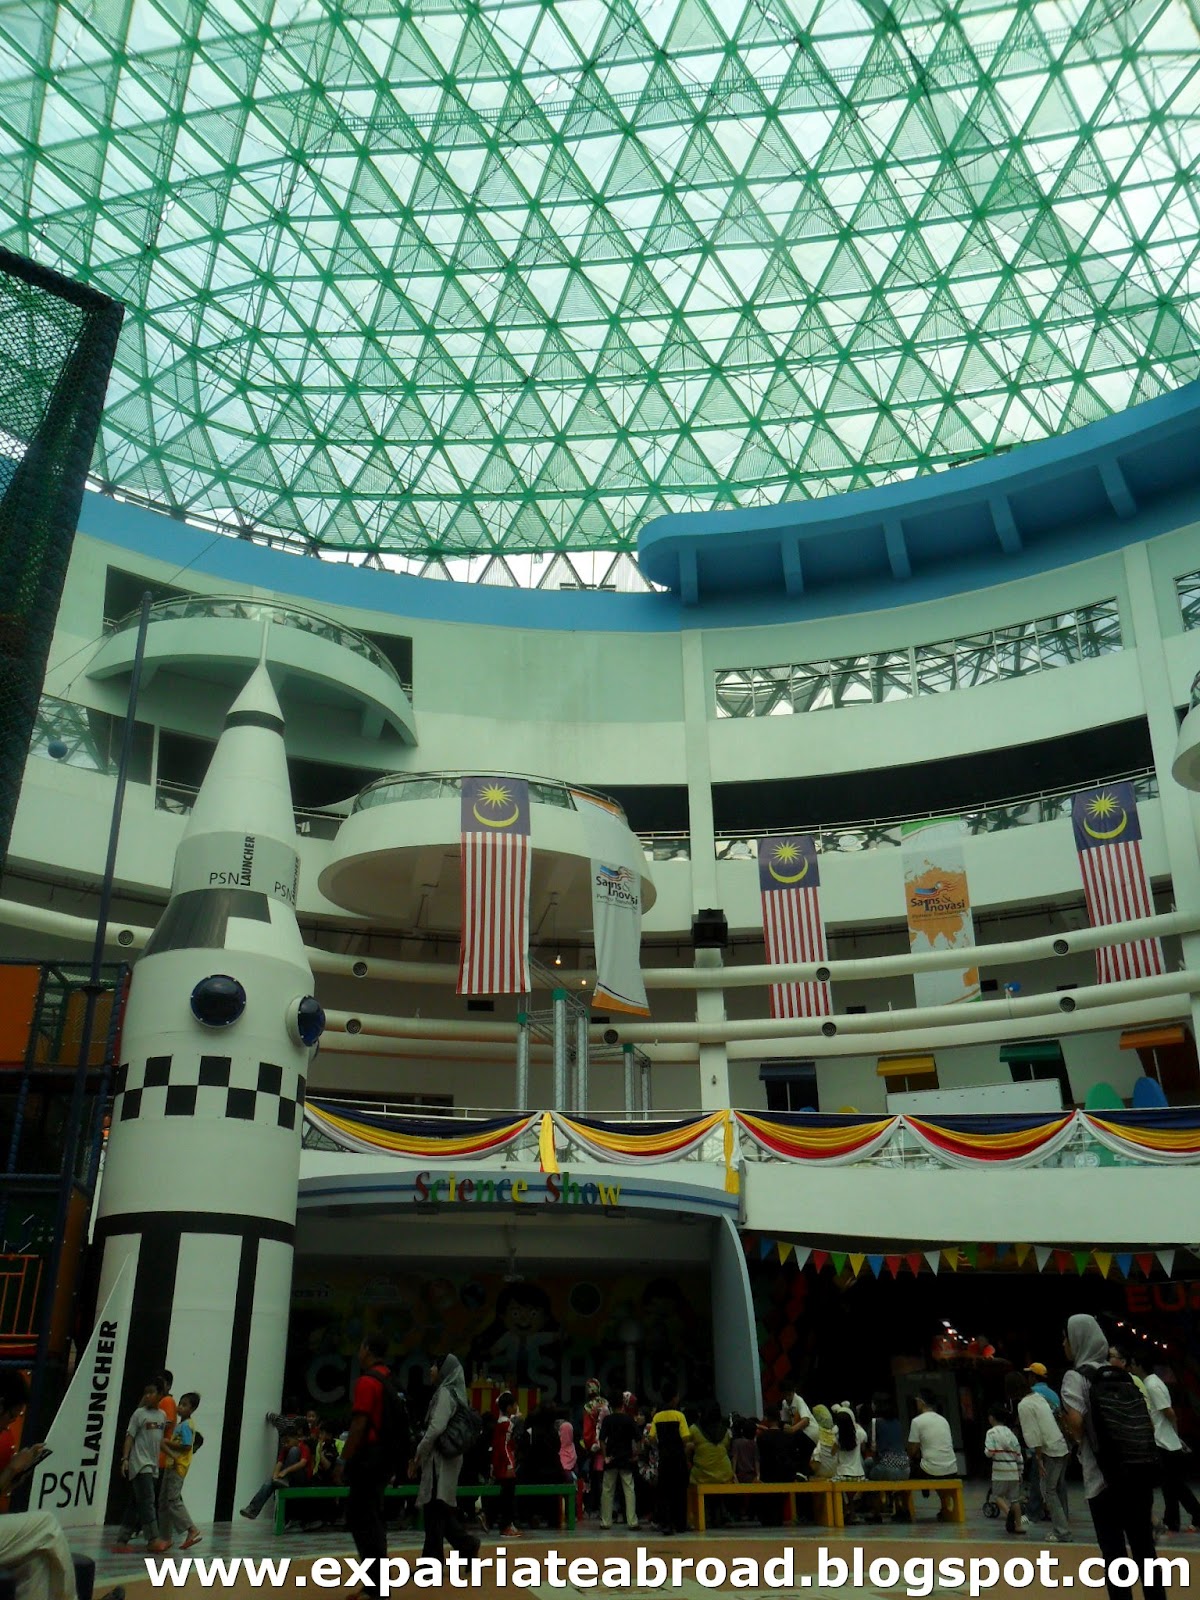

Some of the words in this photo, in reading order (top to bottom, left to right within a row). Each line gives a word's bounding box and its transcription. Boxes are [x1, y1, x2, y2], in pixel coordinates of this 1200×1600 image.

[240, 836, 255, 886] LAUNCHER
[209, 872, 240, 885] PSN
[274, 881, 293, 902] PSN
[911, 897, 940, 909] Sains
[924, 899, 965, 912] Inovasi
[413, 1171, 528, 1203] Science
[544, 1171, 621, 1207] Show
[80, 1320, 118, 1467] LAUNCHER
[38, 1470, 97, 1509] PSN
